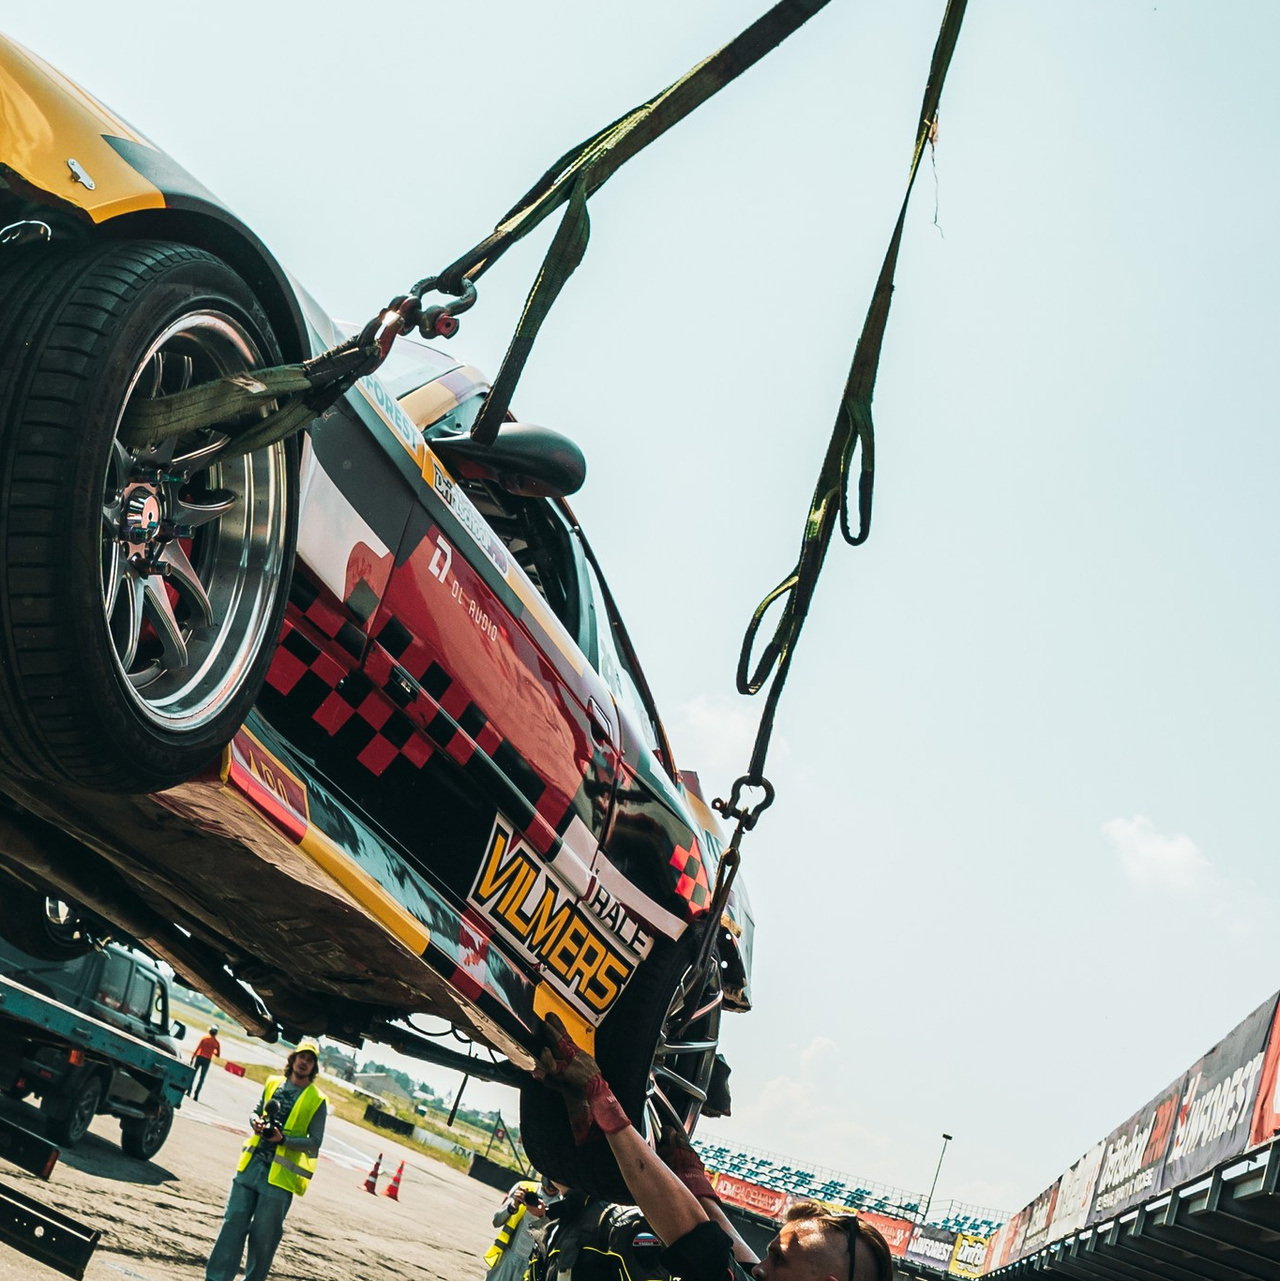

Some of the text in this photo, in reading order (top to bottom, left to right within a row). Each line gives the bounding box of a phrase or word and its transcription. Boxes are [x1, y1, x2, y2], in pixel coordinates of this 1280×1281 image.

[361, 374, 417, 450] FOREST
[468, 600, 498, 642] AUDIO
[471, 822, 635, 1015] VILMERS
